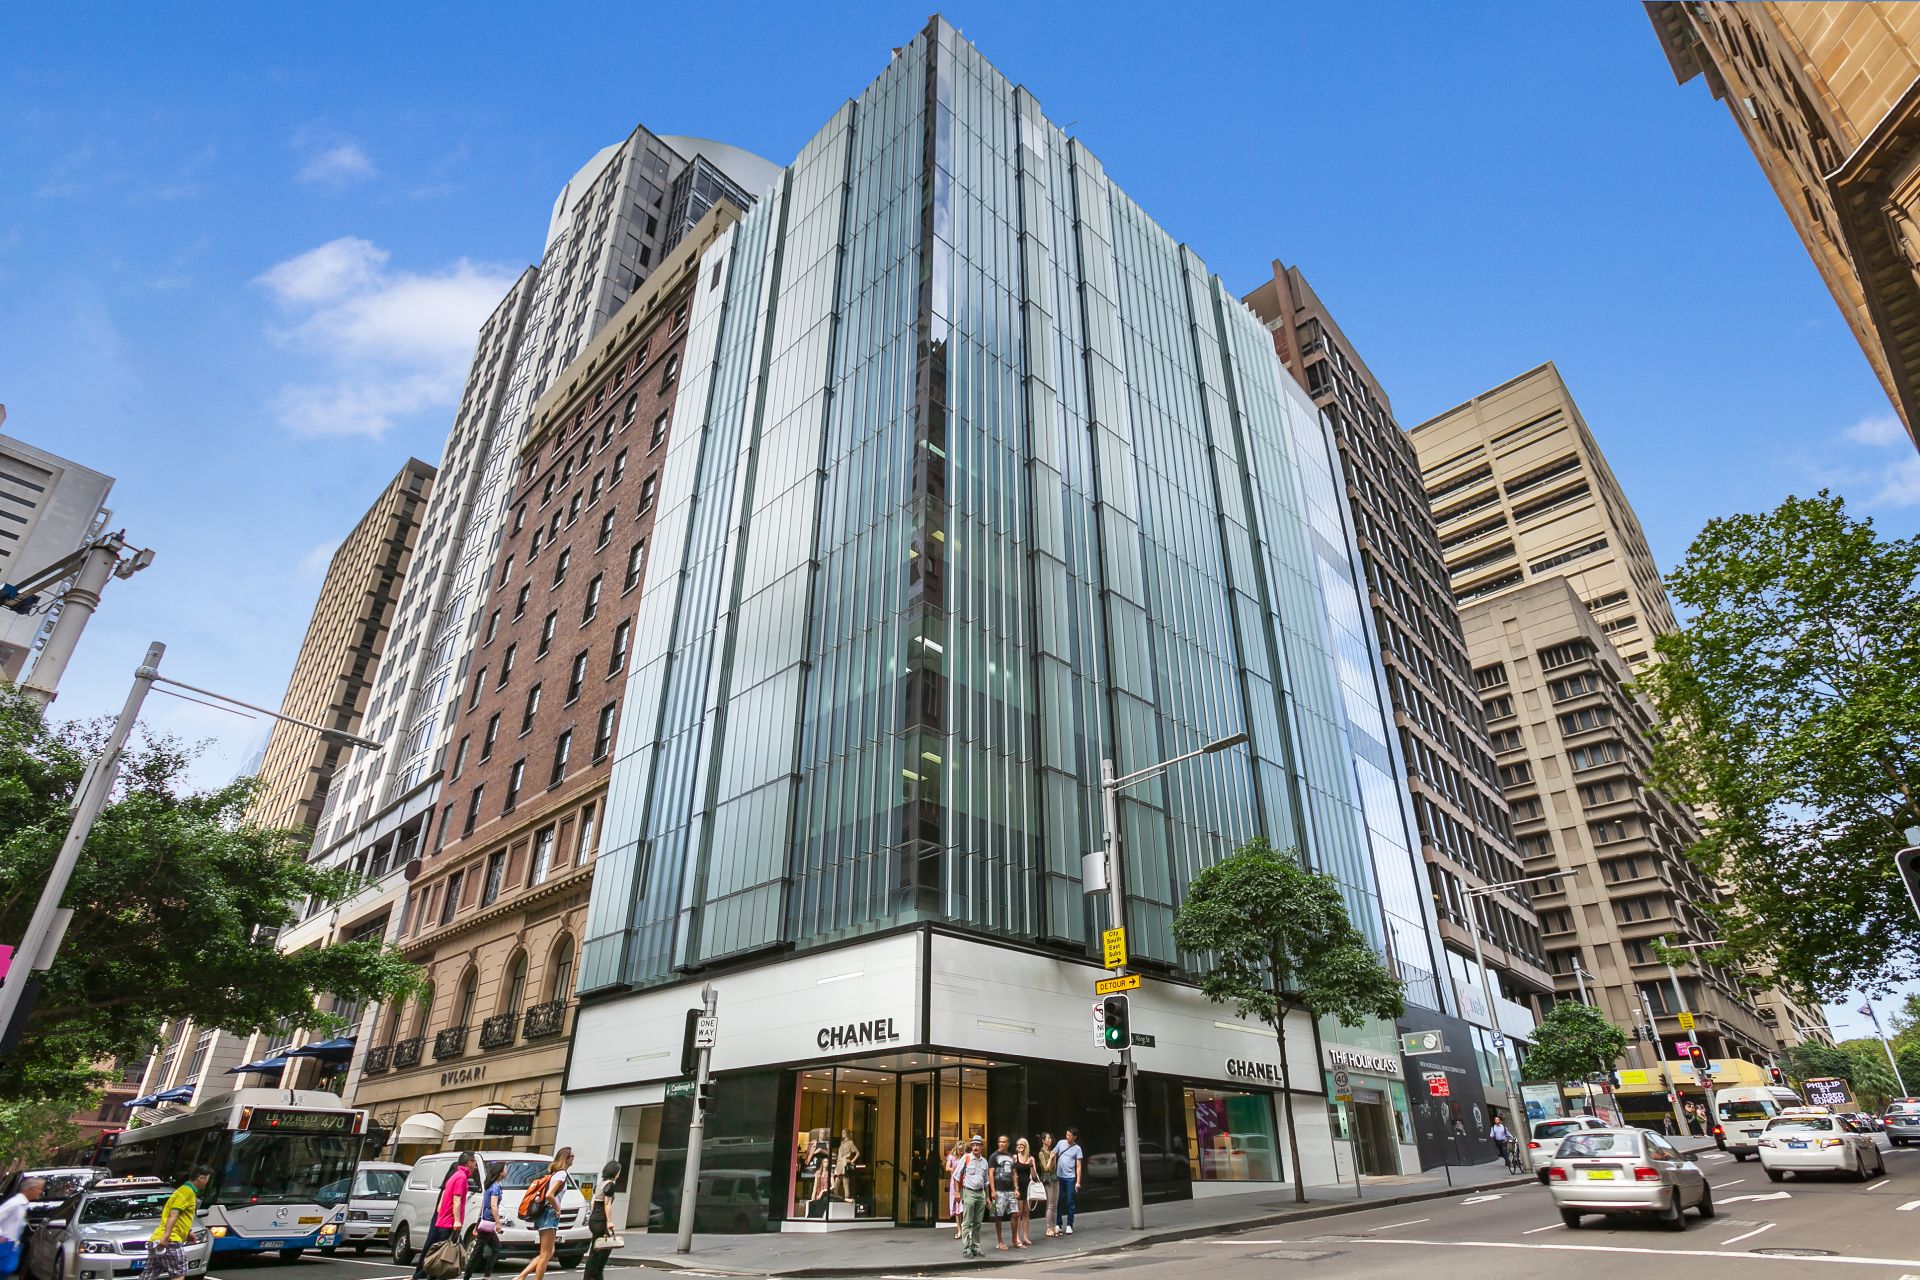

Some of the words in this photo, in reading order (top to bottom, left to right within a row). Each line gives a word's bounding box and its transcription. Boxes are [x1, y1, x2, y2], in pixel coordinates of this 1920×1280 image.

[1099, 980, 1126, 991] DETOUR
[700, 1019, 715, 1028] ONE
[698, 1029, 715, 1037] WAY
[817, 1018, 900, 1050] CHANEL
[1329, 1049, 1348, 1065] THE
[1348, 1053, 1373, 1070] HOUR
[1372, 1057, 1398, 1074] GLASS
[1225, 1058, 1283, 1082] CHANEL
[440, 1065, 487, 1087] BVLGARI
[1336, 1075, 1347, 1084] 40
[1806, 1081, 1840, 1089] PHILLIP
[1811, 1092, 1844, 1100] CLOSED
[320, 1116, 346, 1129] 470
